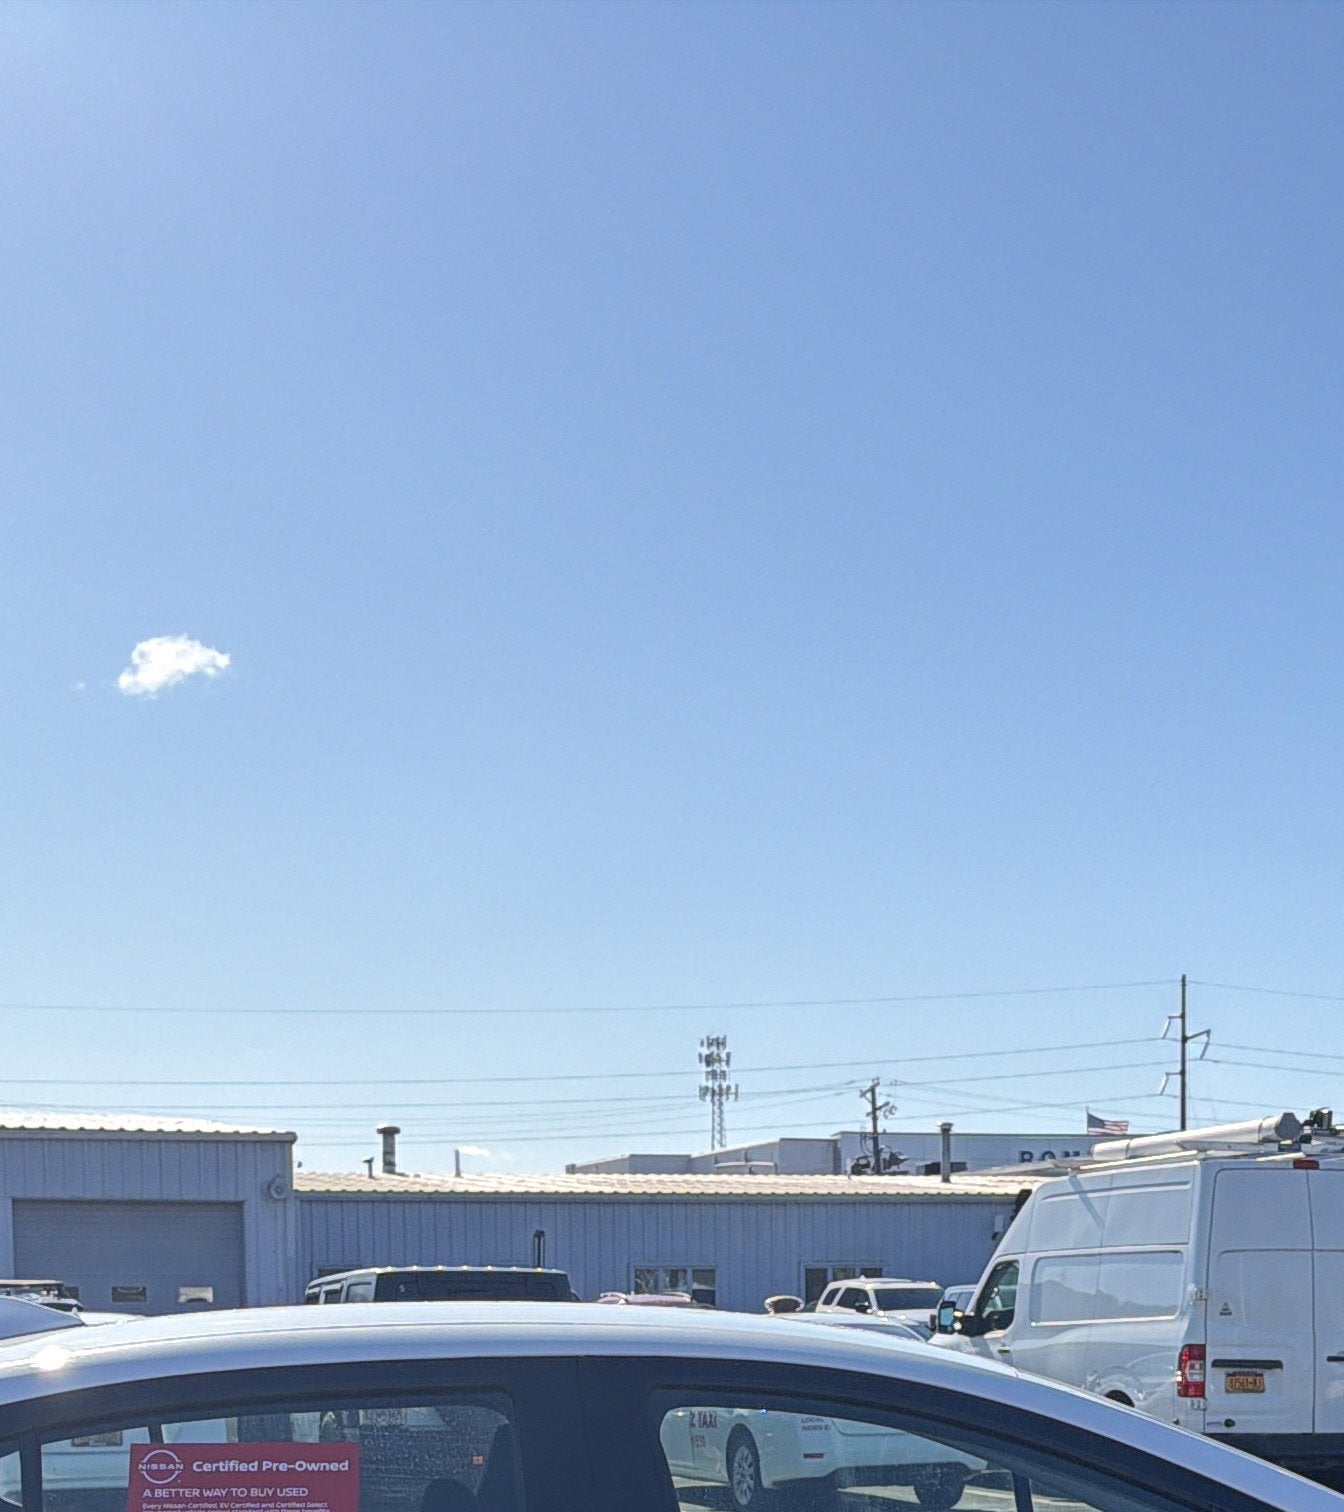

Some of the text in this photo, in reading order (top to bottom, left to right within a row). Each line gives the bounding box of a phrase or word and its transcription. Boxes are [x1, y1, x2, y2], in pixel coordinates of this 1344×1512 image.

[192, 1459, 349, 1472] Certified Pre-Owned
[142, 1487, 309, 1498] A BETTER WAY TO BUY USED
